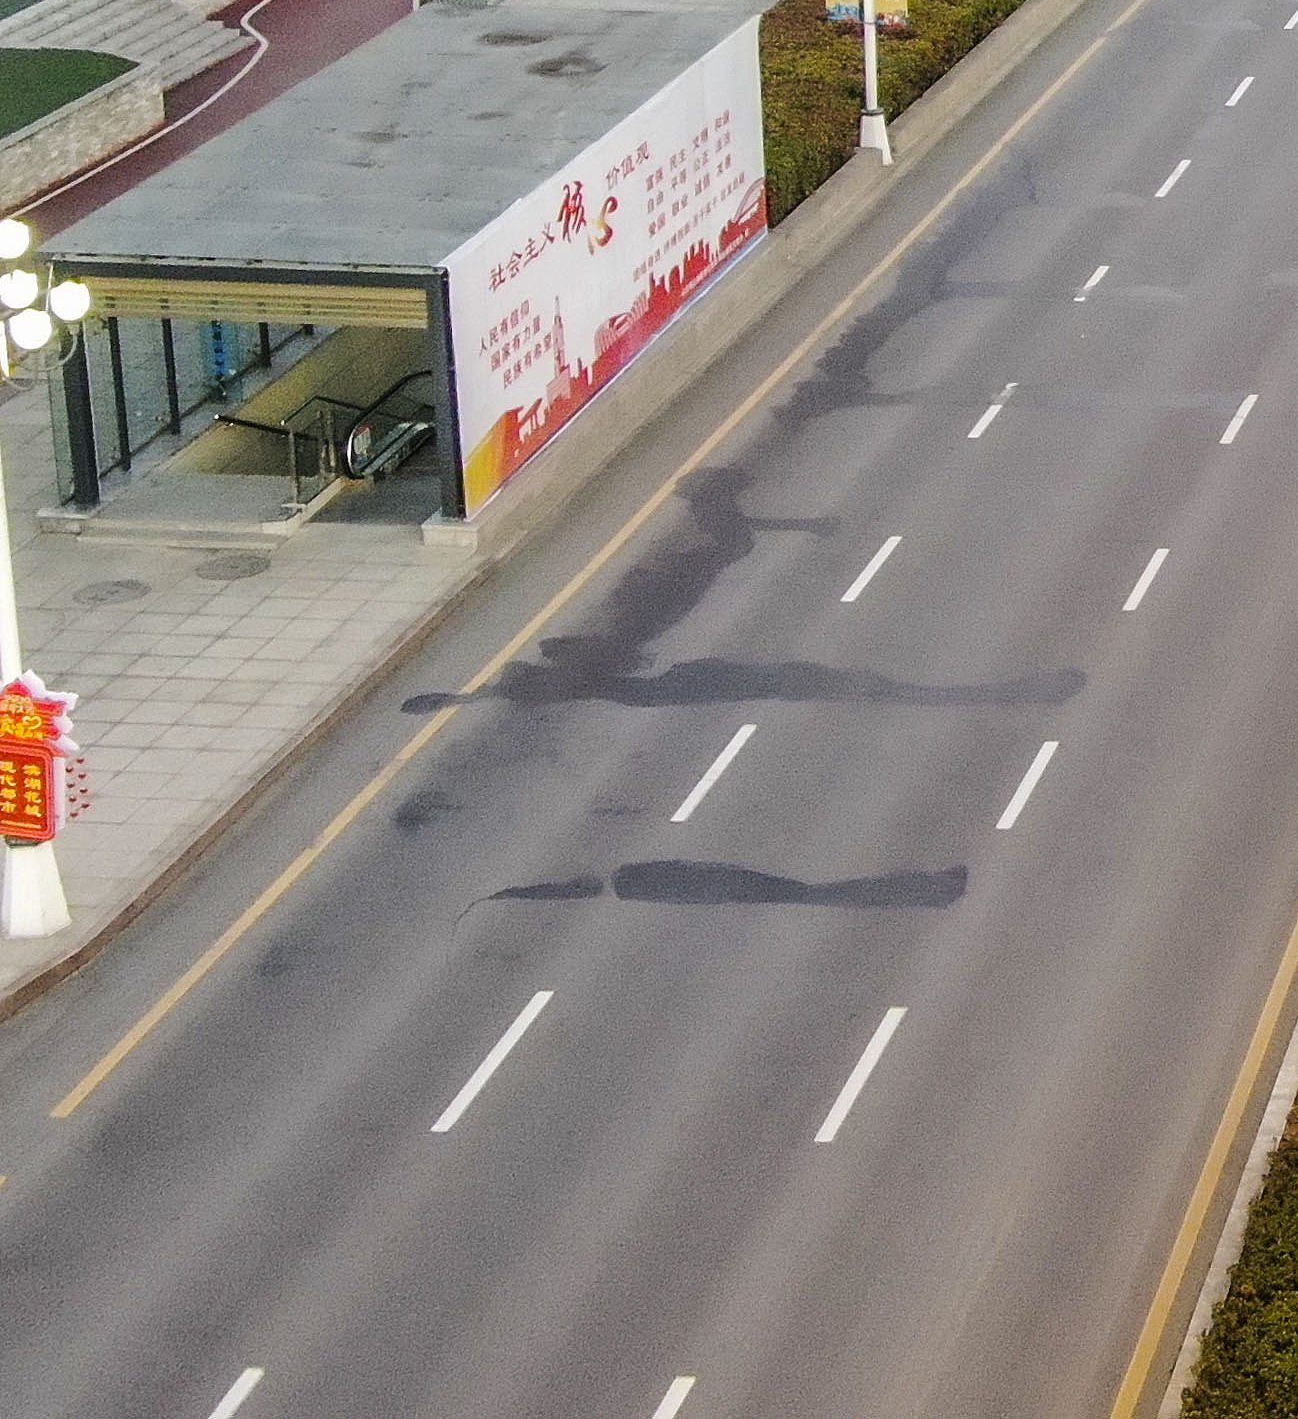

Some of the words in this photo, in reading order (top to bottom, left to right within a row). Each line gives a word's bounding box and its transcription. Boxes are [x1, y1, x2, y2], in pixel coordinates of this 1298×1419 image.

[489, 222, 556, 292] 社会主义
[557, 180, 618, 256] 核心
[606, 141, 650, 190] 价值观
[478, 299, 530, 357] 人民有信仰
[491, 315, 541, 372] 国家有力量
[504, 332, 552, 390] 民族有希望
